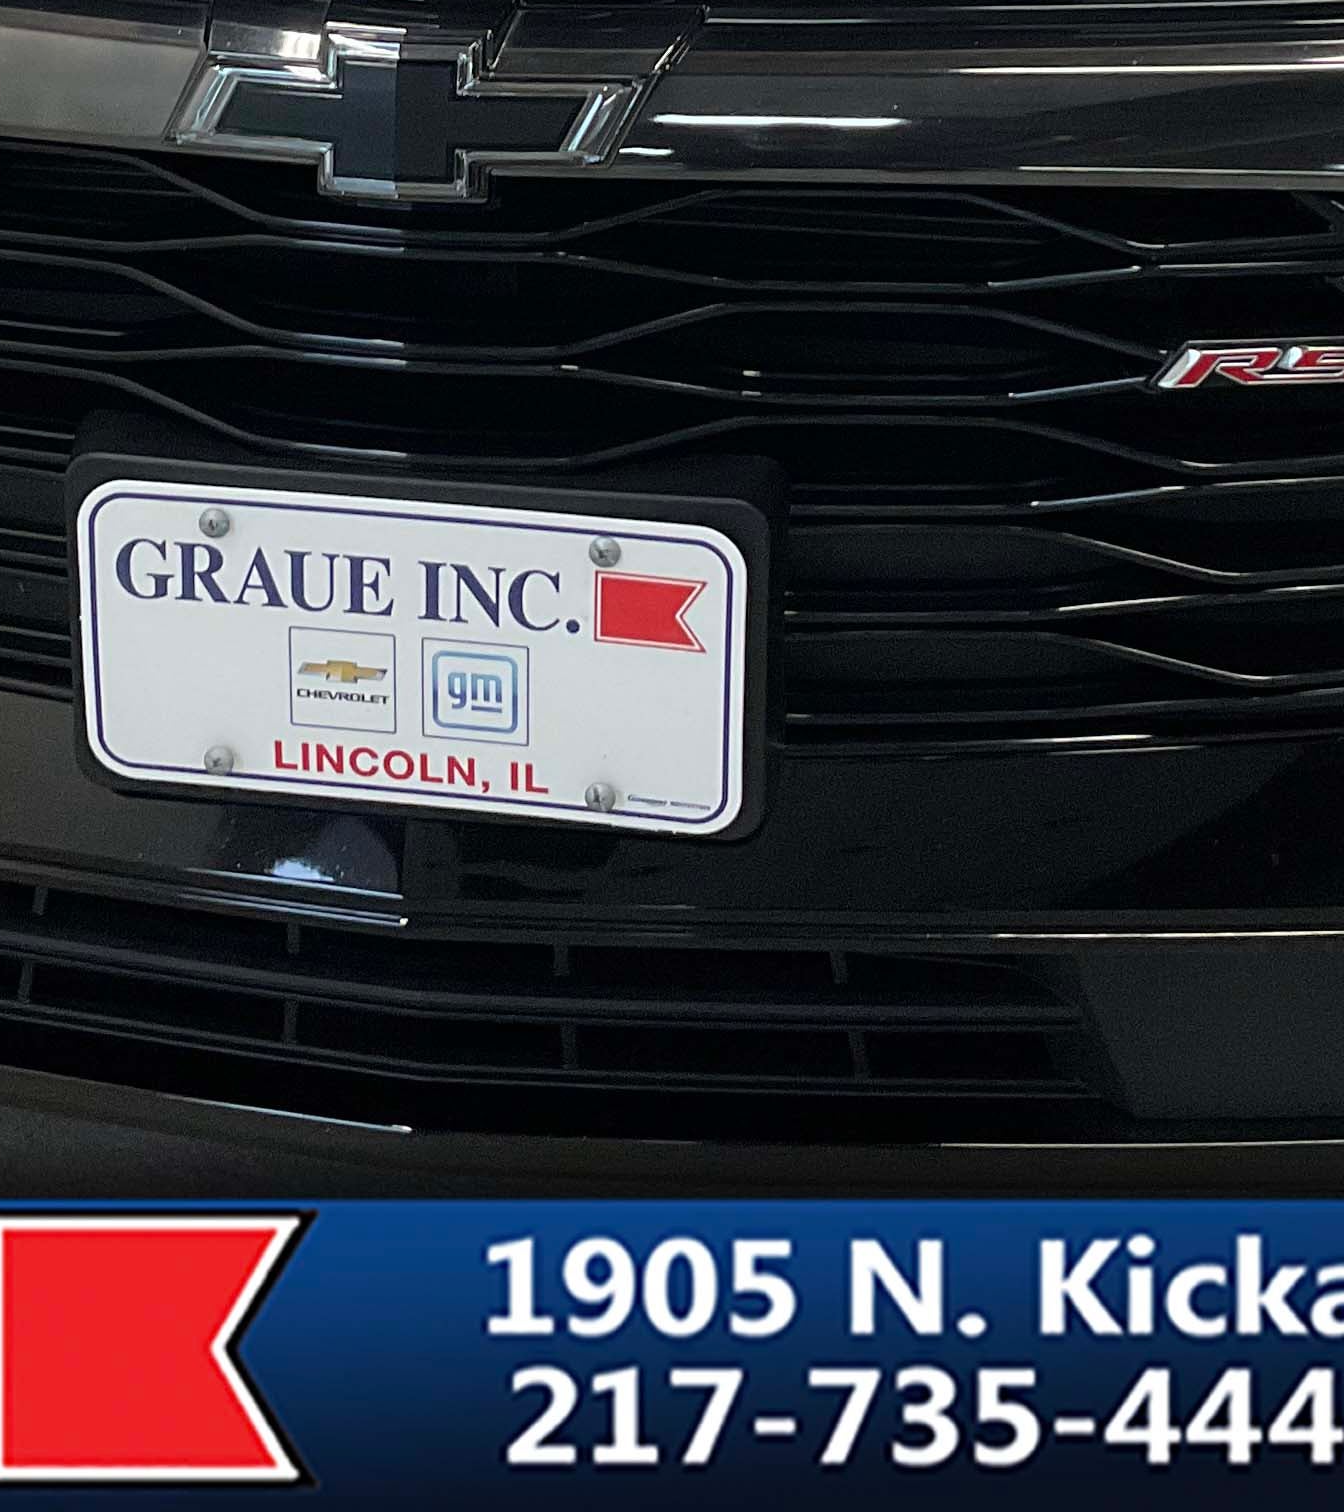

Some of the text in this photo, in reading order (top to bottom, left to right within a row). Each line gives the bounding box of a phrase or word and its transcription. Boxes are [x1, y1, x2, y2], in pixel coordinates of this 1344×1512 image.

[115, 537, 581, 635] GRAUE INC.
[296, 687, 390, 706] CHEVROLET
[447, 671, 504, 714] gm
[273, 739, 549, 794] LINCOLN, IL
